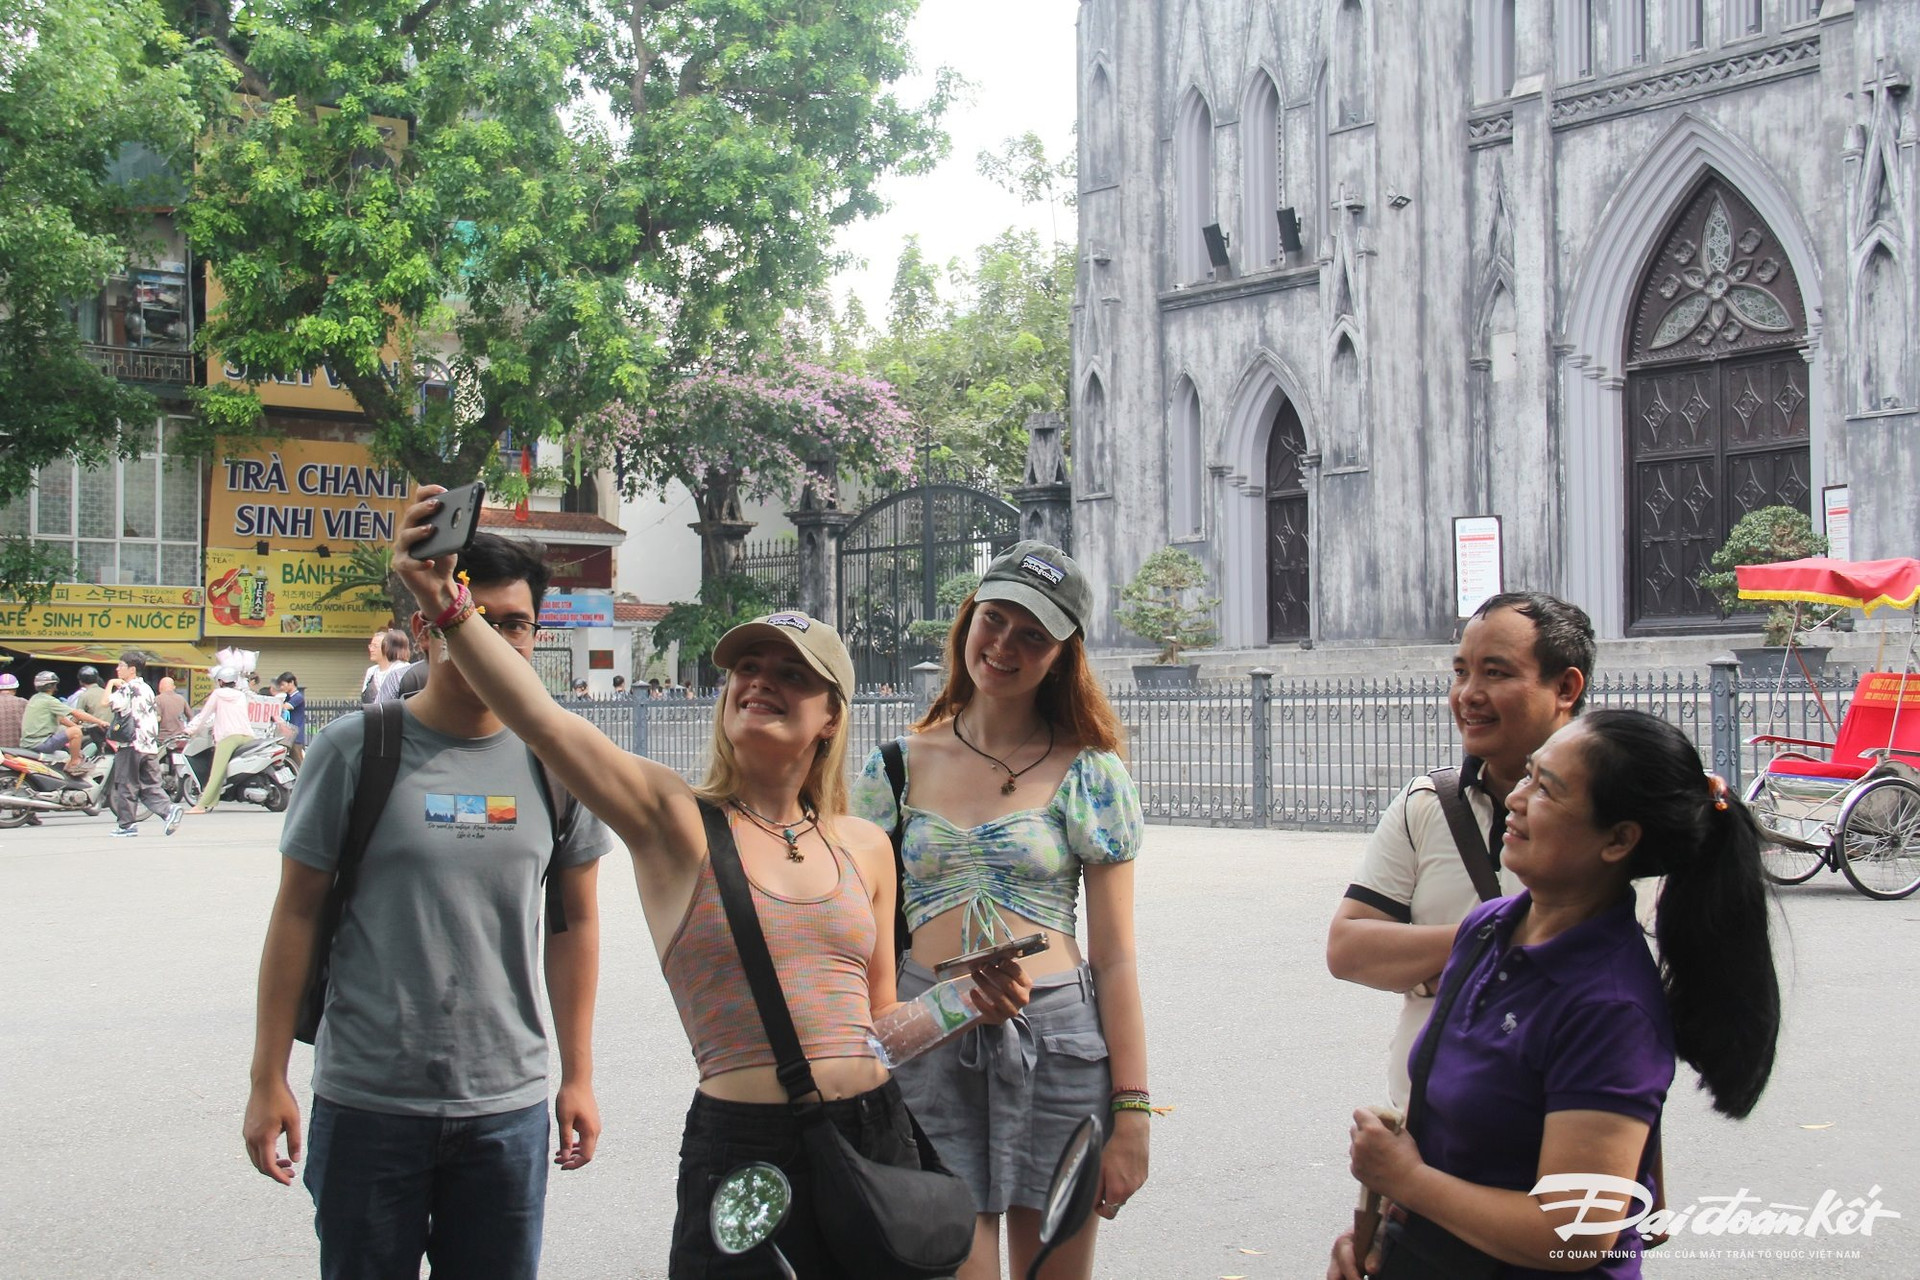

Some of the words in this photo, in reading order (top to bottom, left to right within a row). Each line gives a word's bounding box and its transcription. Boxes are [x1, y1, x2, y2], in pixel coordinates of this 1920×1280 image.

[223, 452, 289, 493] TRÀ
[297, 462, 410, 499] CHANH
[234, 503, 314, 539] SINH
[322, 501, 395, 541] VIÊN
[282, 558, 334, 585] BÁNH
[43, 612, 83, 628] SINH
[88, 608, 112, 628] TỐ
[126, 611, 173, 629] NƯỚC
[178, 611, 196, 629] ÉP
